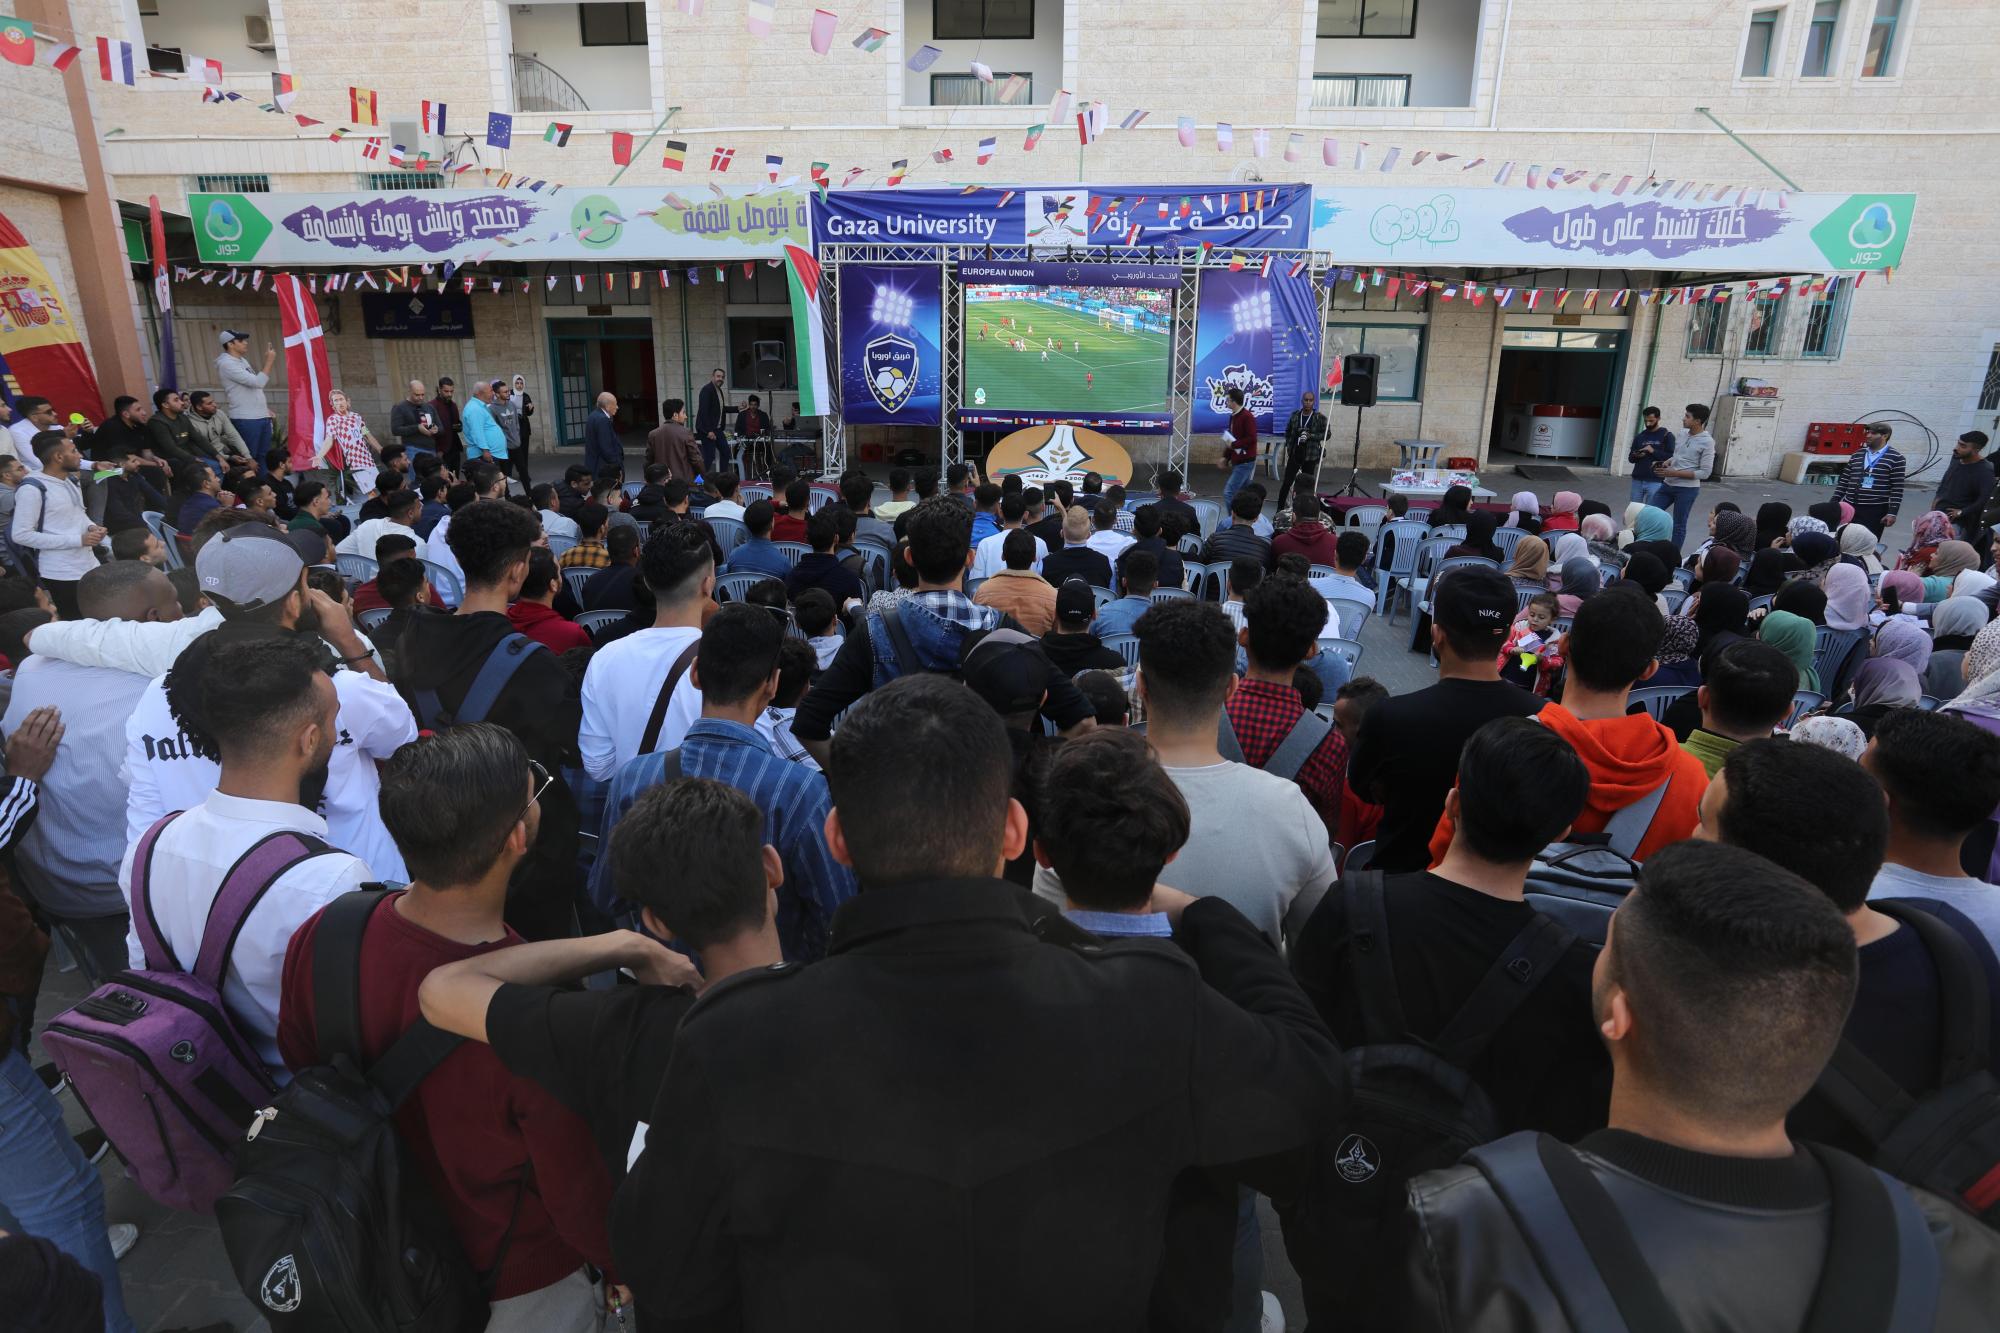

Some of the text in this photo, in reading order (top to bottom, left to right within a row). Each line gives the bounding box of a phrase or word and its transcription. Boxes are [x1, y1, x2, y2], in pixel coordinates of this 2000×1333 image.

[302, 207, 366, 241] بابتسامة
[371, 208, 413, 242] يومك
[470, 205, 519, 236] صحصح
[827, 213, 997, 240] Gaza University
[1553, 212, 1597, 248] طول
[1602, 212, 1645, 246] على
[1651, 208, 1700, 248] نشيط
[215, 244, 240, 256] جوال
[1849, 251, 1883, 265] جوال
[962, 267, 1035, 277] EUROPEAN UNION
[892, 351, 911, 361] فريق
[1478, 609, 1502, 619] NIKE
